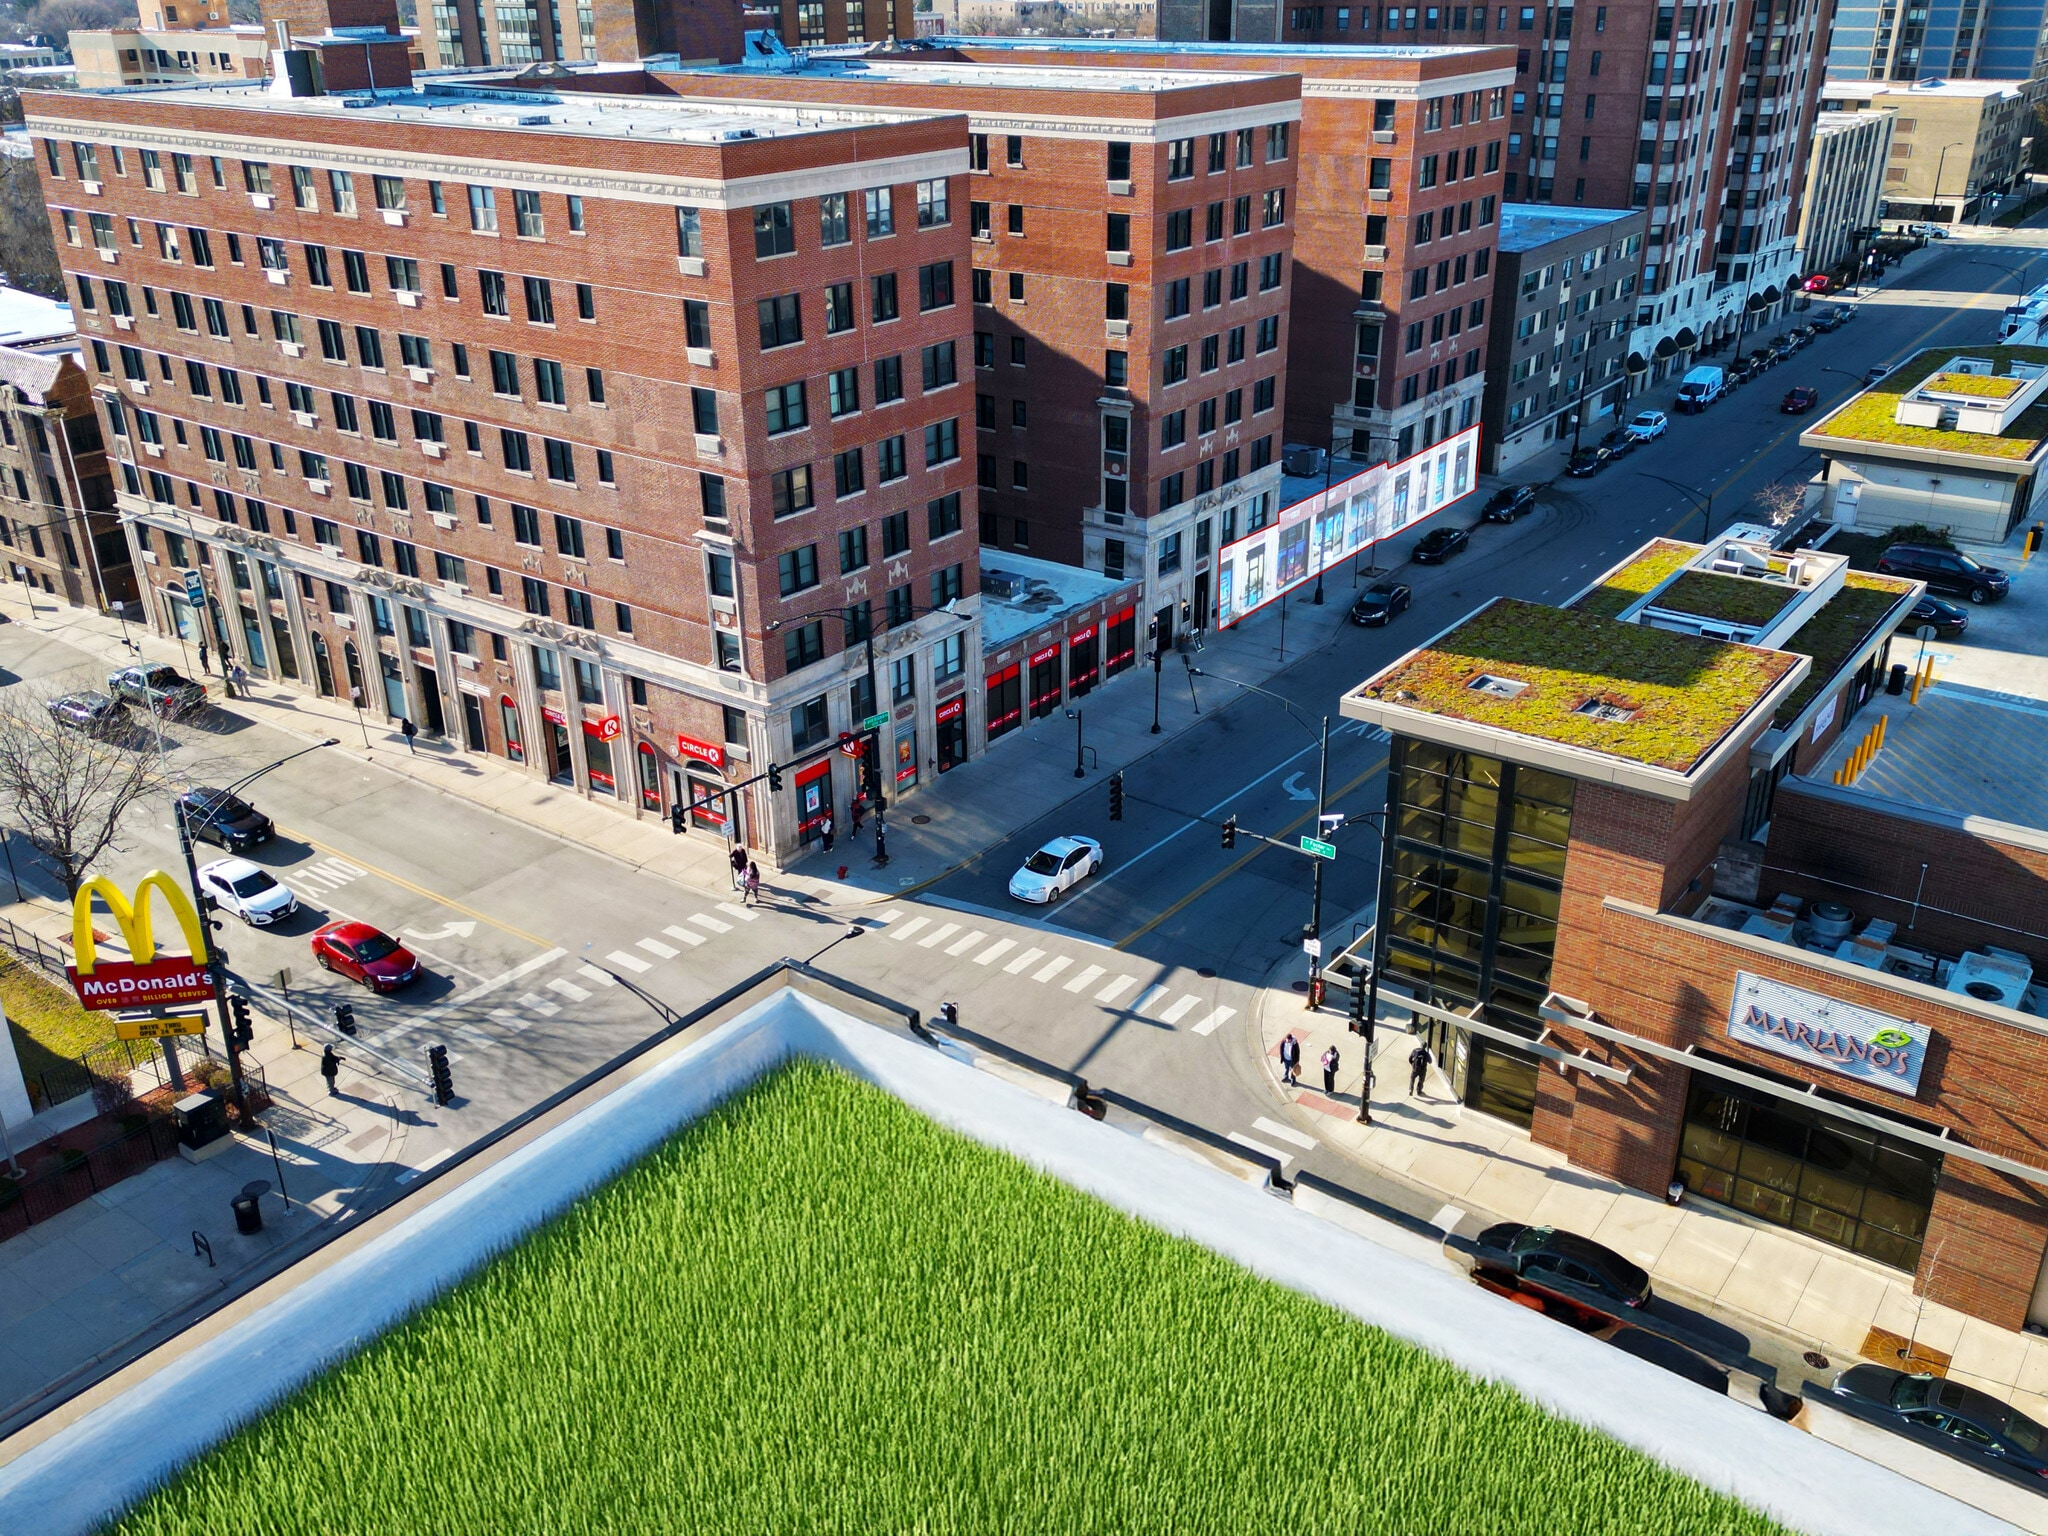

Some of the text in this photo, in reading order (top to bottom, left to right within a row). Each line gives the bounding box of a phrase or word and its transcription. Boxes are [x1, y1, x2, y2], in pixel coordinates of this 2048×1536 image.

[681, 741, 708, 757] CIRCLE
[283, 857, 369, 898] ONLY
[83, 972, 213, 996] McDonald's
[96, 997, 118, 1006] OVER
[143, 993, 174, 1002] BILLION
[178, 990, 208, 999] SERVED
[139, 1021, 182, 1031] DRIVE THRU
[139, 1029, 157, 1037] OPEN
[1741, 1004, 1910, 1076] MARIANO'S
